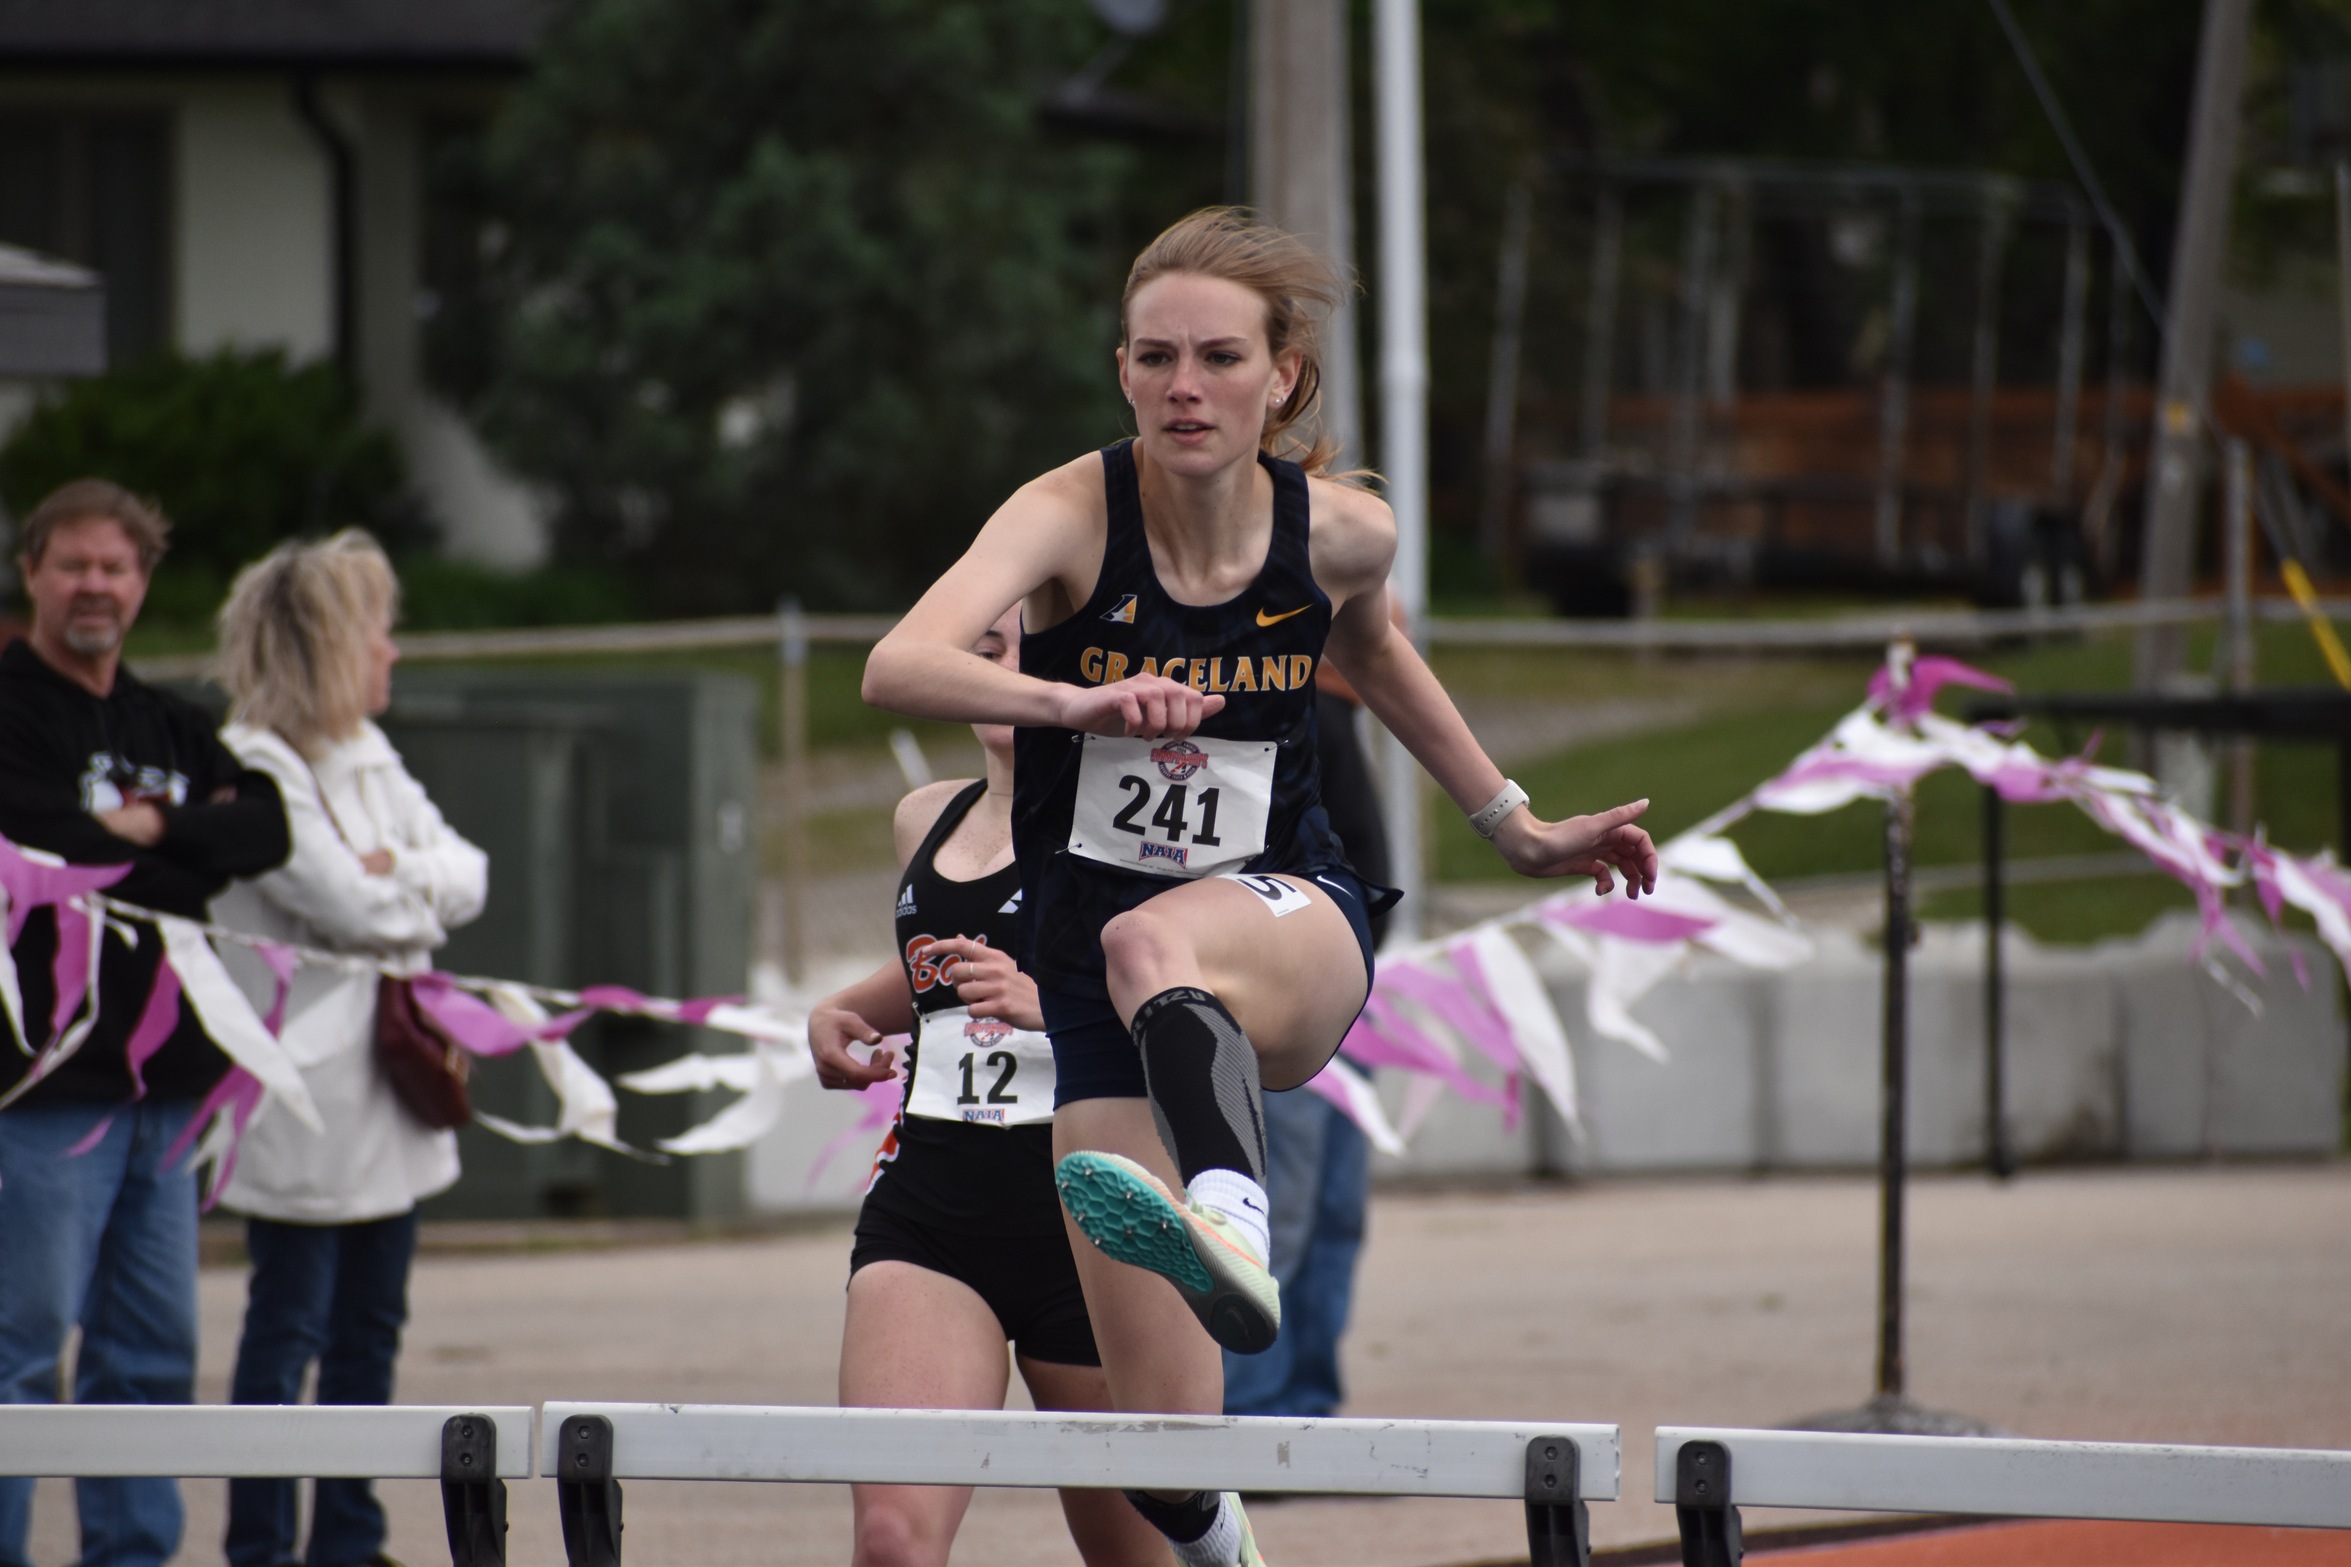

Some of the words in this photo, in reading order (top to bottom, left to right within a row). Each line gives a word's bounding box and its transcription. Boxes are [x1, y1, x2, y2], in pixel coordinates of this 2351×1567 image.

[1080, 646, 1312, 692] GRACELAND
[1112, 775, 1221, 847] 241
[1141, 843, 1185, 865] NAIA
[957, 1051, 1018, 1105] 12
[964, 1110, 1002, 1122] NAIA
